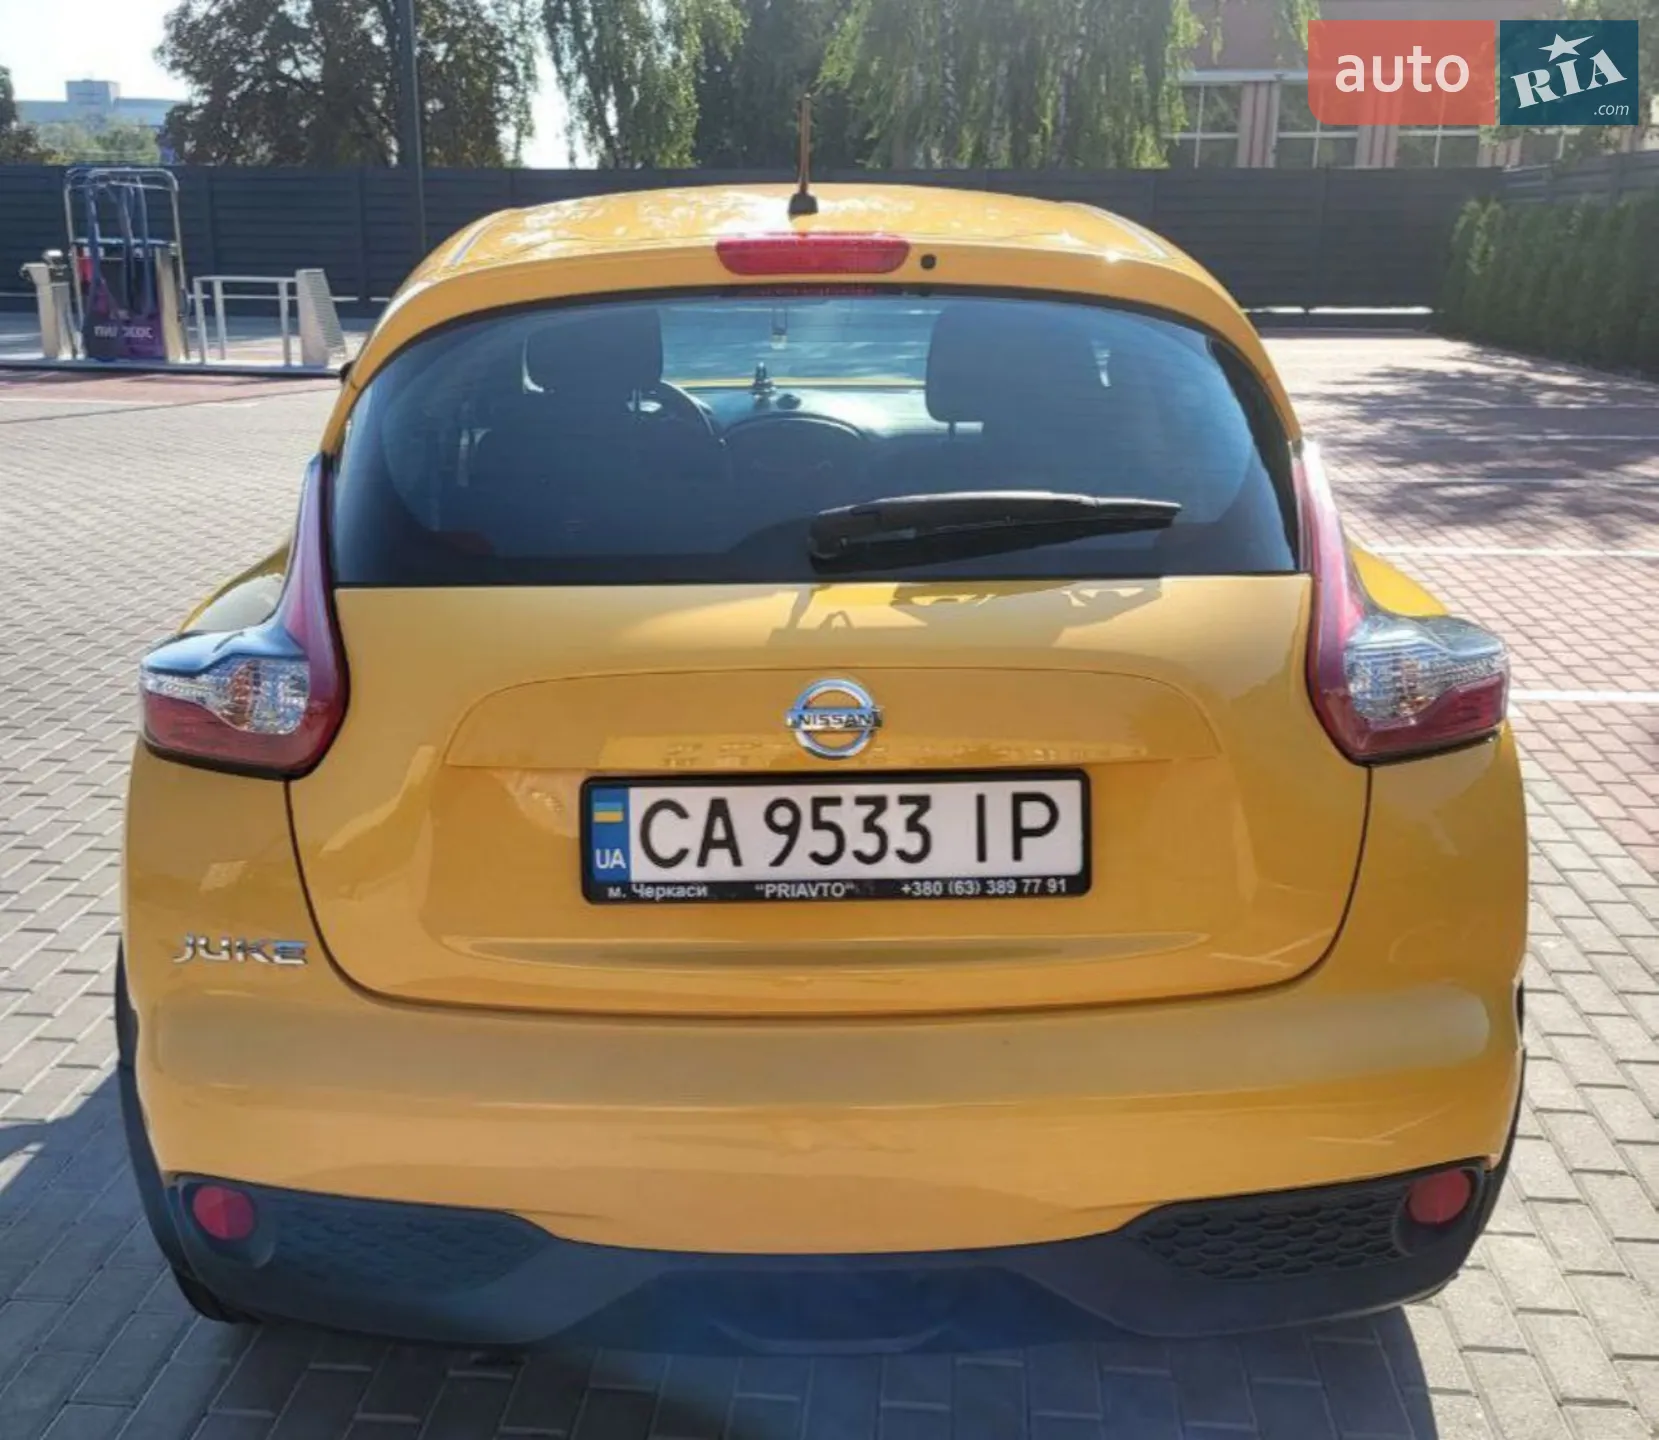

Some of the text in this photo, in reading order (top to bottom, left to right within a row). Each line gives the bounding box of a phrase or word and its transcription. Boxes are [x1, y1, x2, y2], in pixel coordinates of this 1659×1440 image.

[799, 714, 872, 728] NISSAN
[639, 791, 1060, 869] CA 9533 IP
[595, 849, 626, 870] UA
[608, 884, 708, 902] м. Черкаси
[901, 878, 1067, 896] +380 (63) 389 77 91
[172, 934, 308, 965] JUKE
